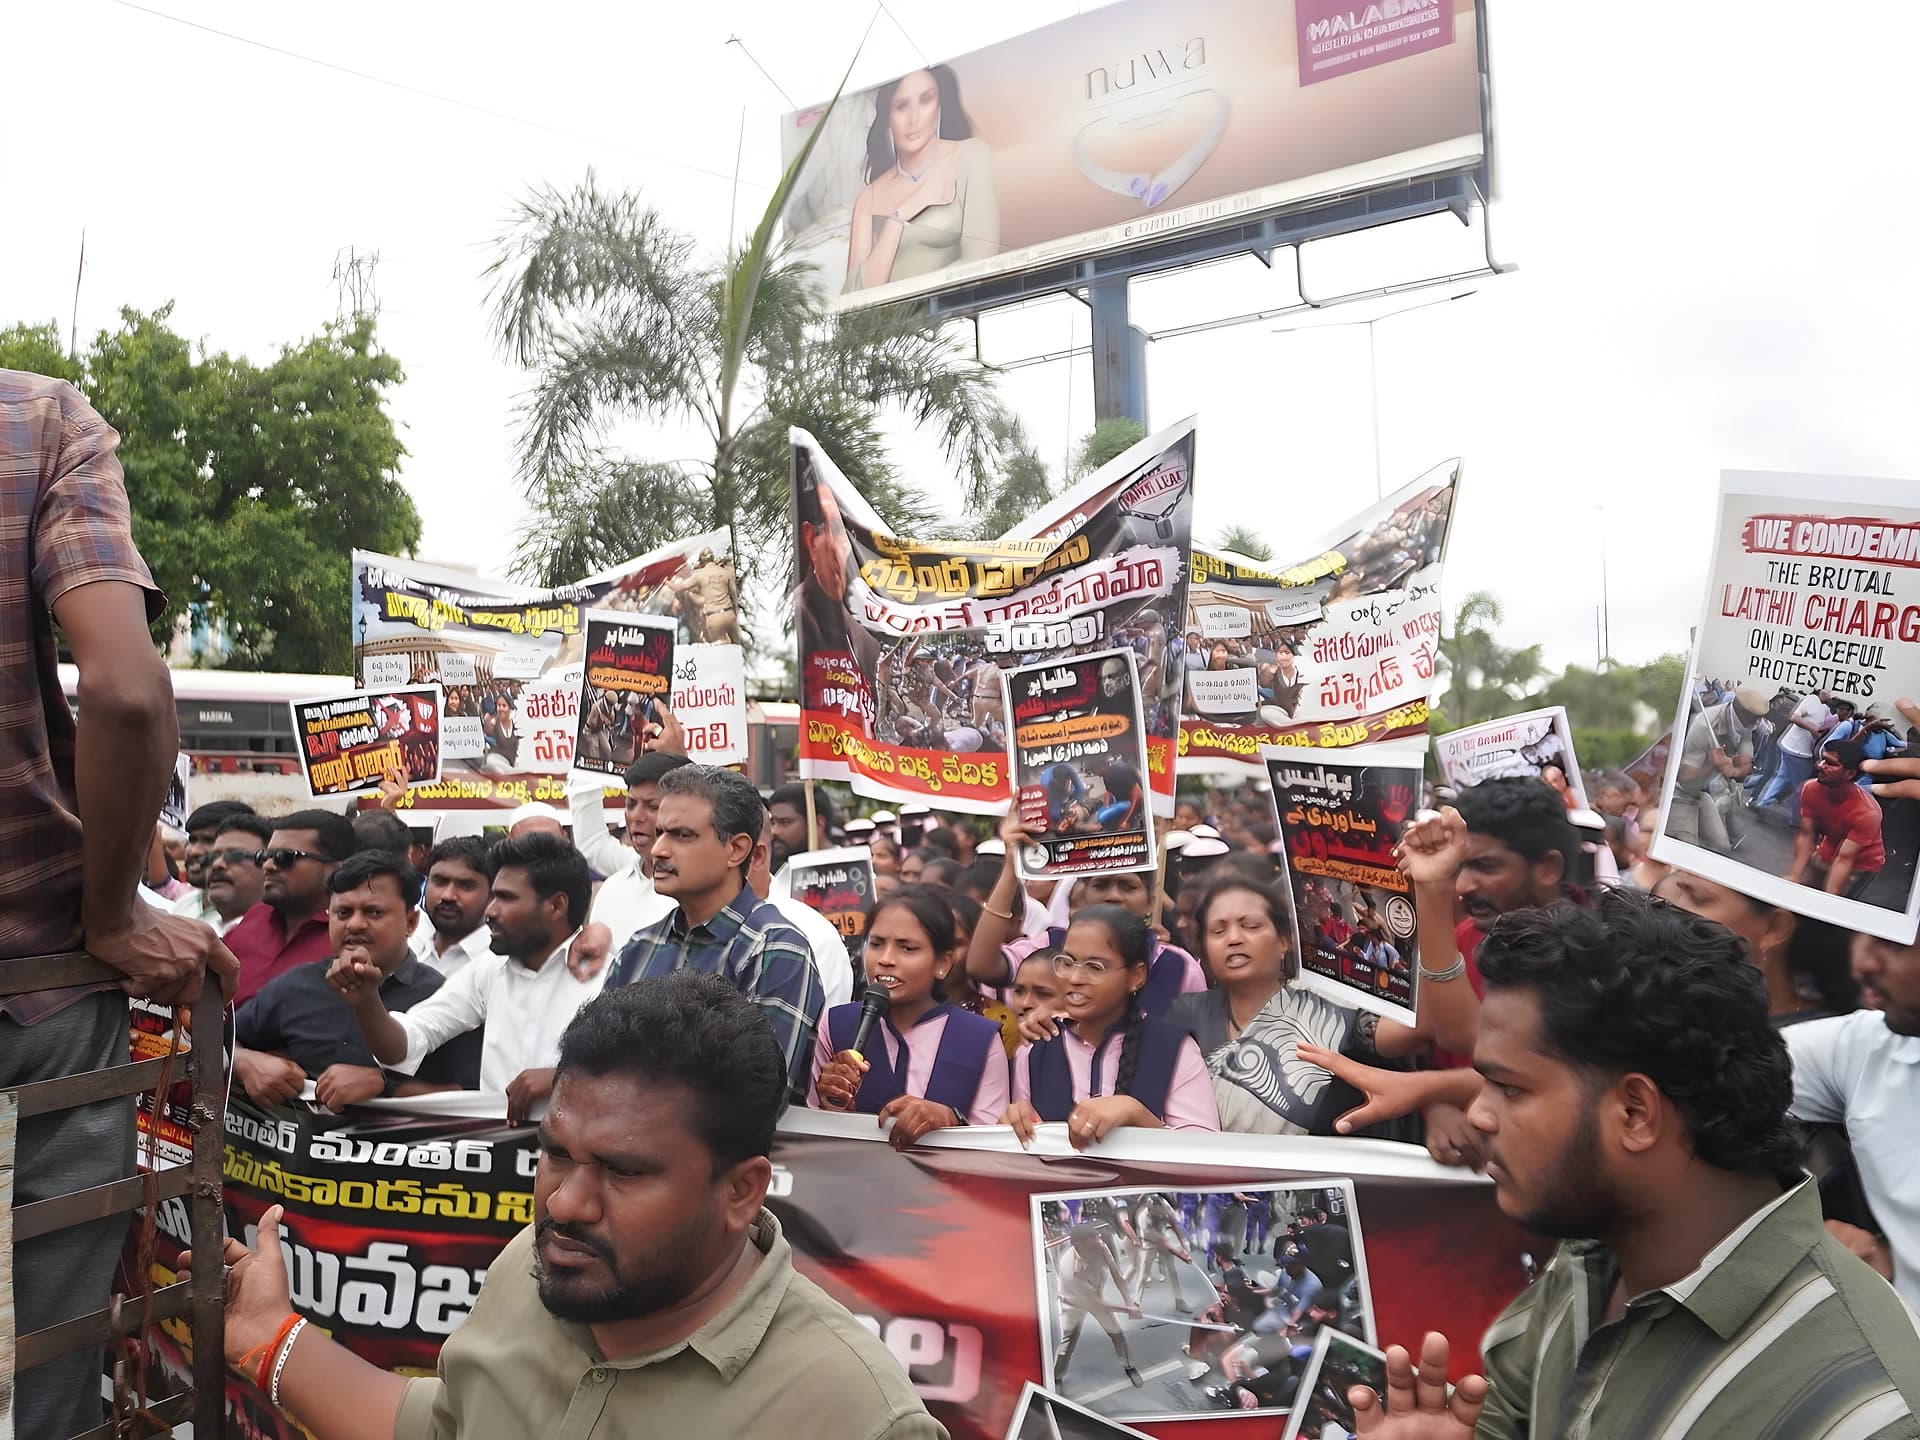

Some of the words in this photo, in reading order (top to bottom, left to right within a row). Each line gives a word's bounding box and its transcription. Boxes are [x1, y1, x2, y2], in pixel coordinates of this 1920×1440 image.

[1086, 36, 1205, 100] nuwa
[1755, 519, 1793, 550] WE
[1793, 521, 1920, 562] CONDEMN
[1767, 561, 1802, 585] THE
[1808, 565, 1895, 596] BRUTAL
[1721, 584, 1798, 627] LATHI
[1749, 627, 1774, 651] ON
[1778, 632, 1887, 670] PEACEFUL
[1748, 656, 1876, 697] PROTESTERS
[305, 731, 339, 757] BJP
[942, 754, 998, 787] వేదిక
[1276, 766, 1352, 801] پولیس
[225, 1112, 298, 1154] జంతర్
[309, 1131, 494, 1173] మంతర్
